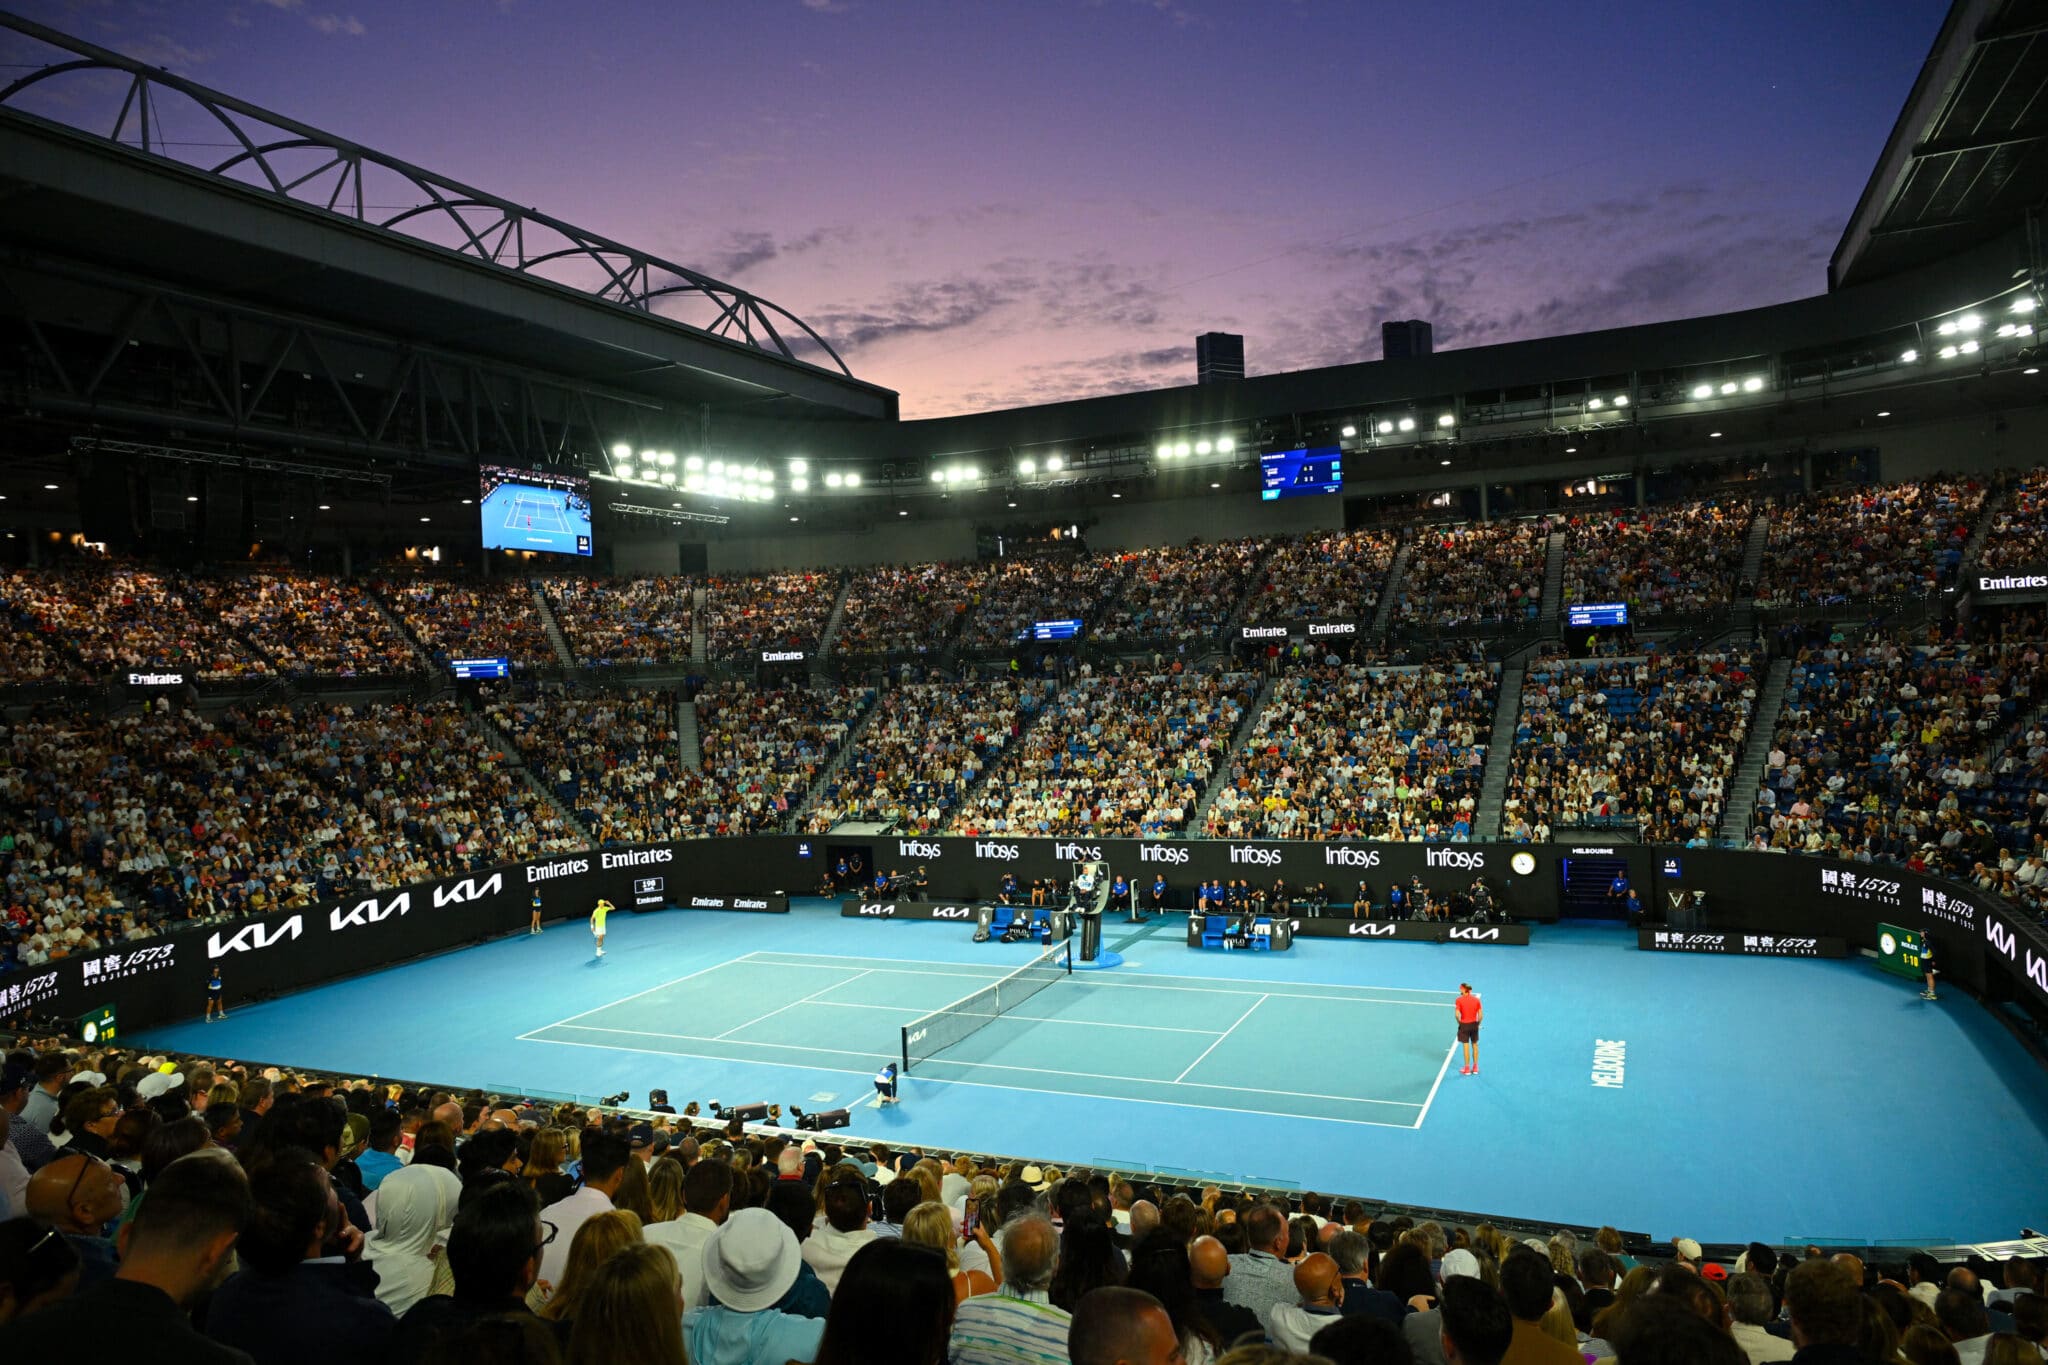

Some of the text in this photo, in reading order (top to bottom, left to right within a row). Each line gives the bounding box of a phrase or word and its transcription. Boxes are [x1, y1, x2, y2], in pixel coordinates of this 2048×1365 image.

[1980, 576, 2048, 591] Emirates
[1243, 627, 1287, 637] Emirates
[1308, 623, 1355, 634] Emirates
[762, 650, 804, 661] Emirates
[128, 672, 183, 685] Emirates
[602, 848, 674, 871] Emirates
[899, 839, 941, 860] Infosys
[975, 840, 1019, 862] Infosys
[1140, 843, 1189, 866] Infosys
[1230, 844, 1282, 867] Infosys
[1325, 846, 1380, 869] Infosys
[1426, 846, 1485, 871] Infosys
[1572, 847, 1614, 855] MELBOURNE
[524, 858, 590, 884] Emirates
[1665, 860, 1677, 868] 16
[433, 873, 503, 908] KIA
[636, 896, 664, 905] Emirates
[1822, 885, 1901, 907] GUOJIAO 1573
[330, 892, 412, 932] KIA
[691, 897, 724, 909] Emirates
[733, 899, 768, 911] Emirates
[206, 914, 303, 960] KIA
[1348, 922, 1396, 936] KIA
[1449, 926, 1499, 941] KIA
[83, 959, 175, 987] GUOJIAO 1573
[37, 988, 58, 1002] 1573
[1591, 1039, 1626, 1088] MELBOURNE
